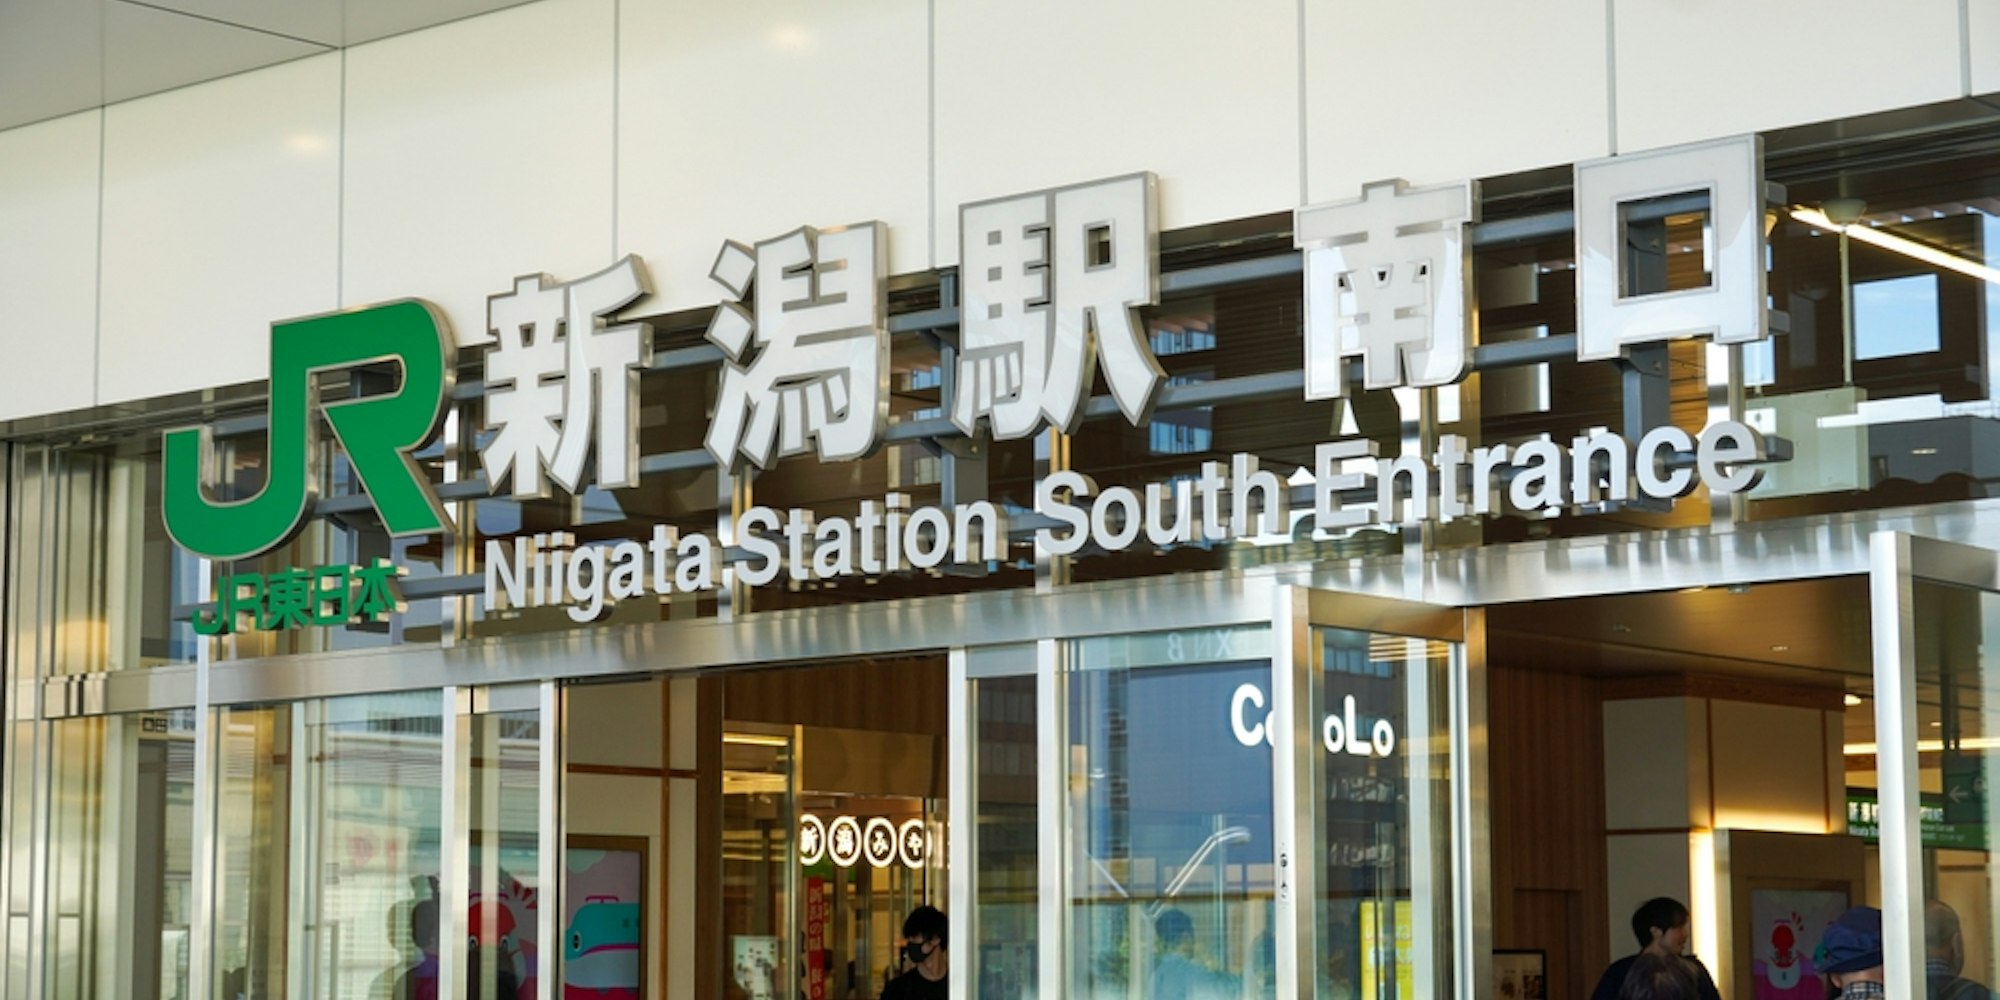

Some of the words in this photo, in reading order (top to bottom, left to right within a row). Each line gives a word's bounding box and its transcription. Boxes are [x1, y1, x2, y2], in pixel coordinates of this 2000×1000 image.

[481, 171, 1163, 499] 新潟駅
[1294, 133, 1768, 401] 南口
[162, 297, 456, 561] JR
[484, 524, 712, 622] Niigata
[735, 492, 1000, 587] Station
[1035, 453, 1281, 555] South
[1313, 420, 1762, 534] Entrance
[192, 557, 398, 635] JR東日本
[1231, 683, 1394, 757] CoLo
